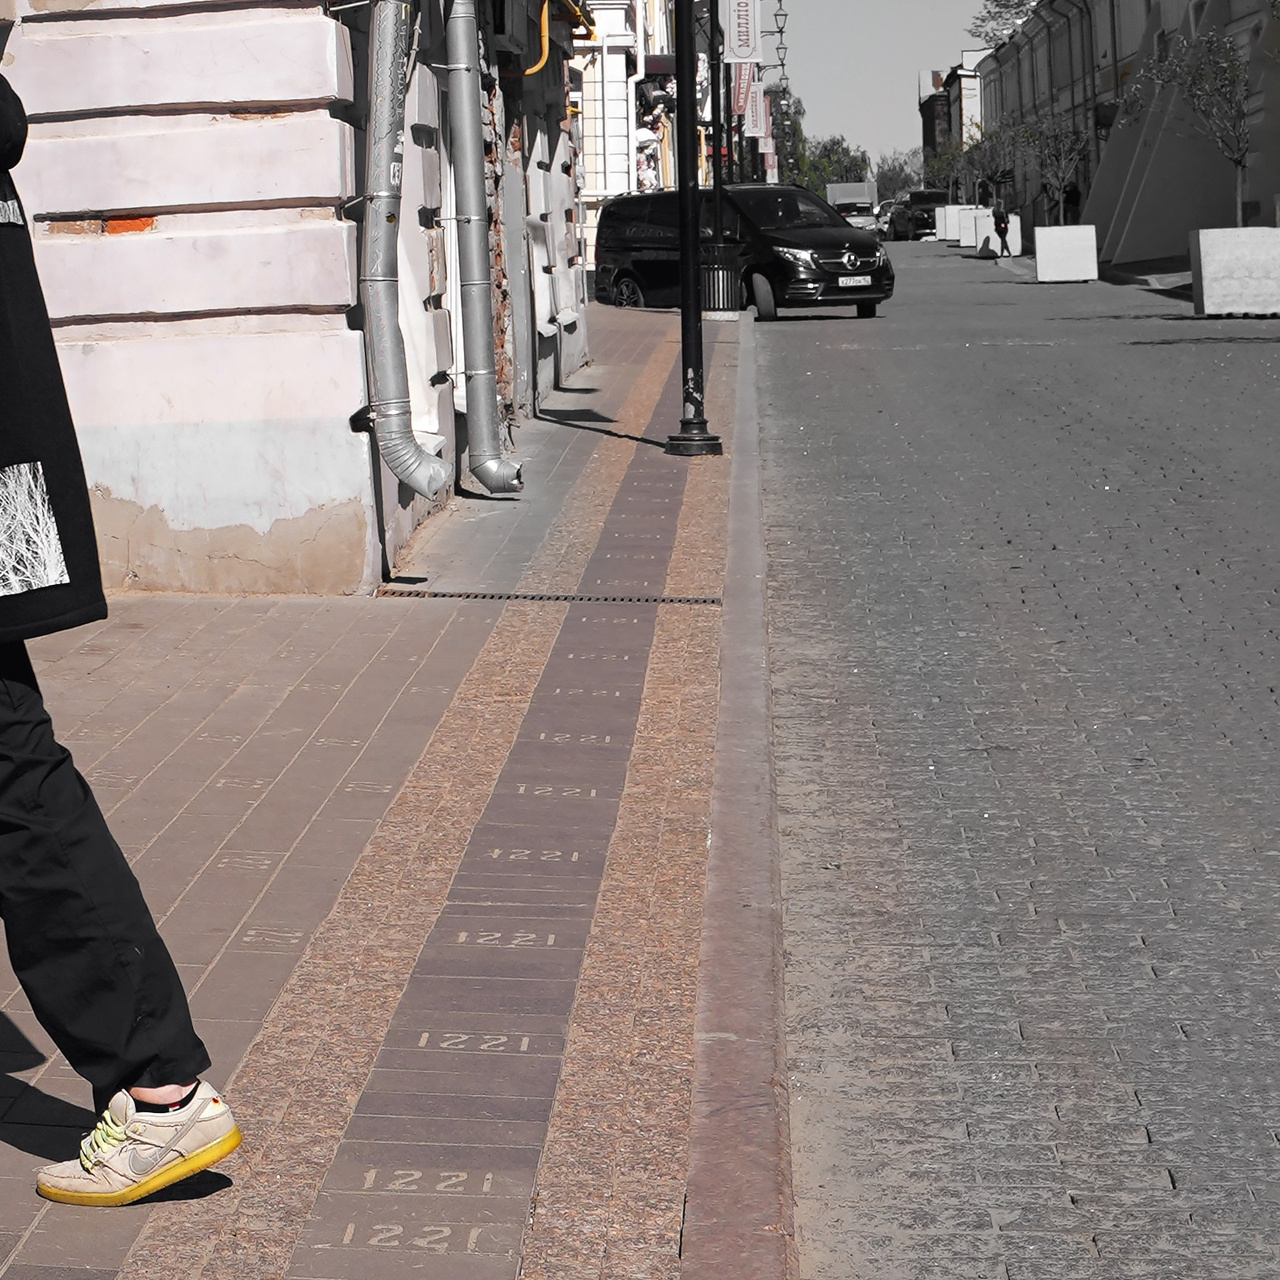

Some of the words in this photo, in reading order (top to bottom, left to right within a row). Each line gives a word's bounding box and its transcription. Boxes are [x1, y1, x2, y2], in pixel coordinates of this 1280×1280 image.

[539, 732, 612, 743] 1221
[517, 784, 598, 797] 1221
[456, 930, 556, 946] 1221
[418, 1031, 530, 1052] 1221
[363, 1169, 493, 1193] 1221
[342, 1222, 482, 1253] 1221
